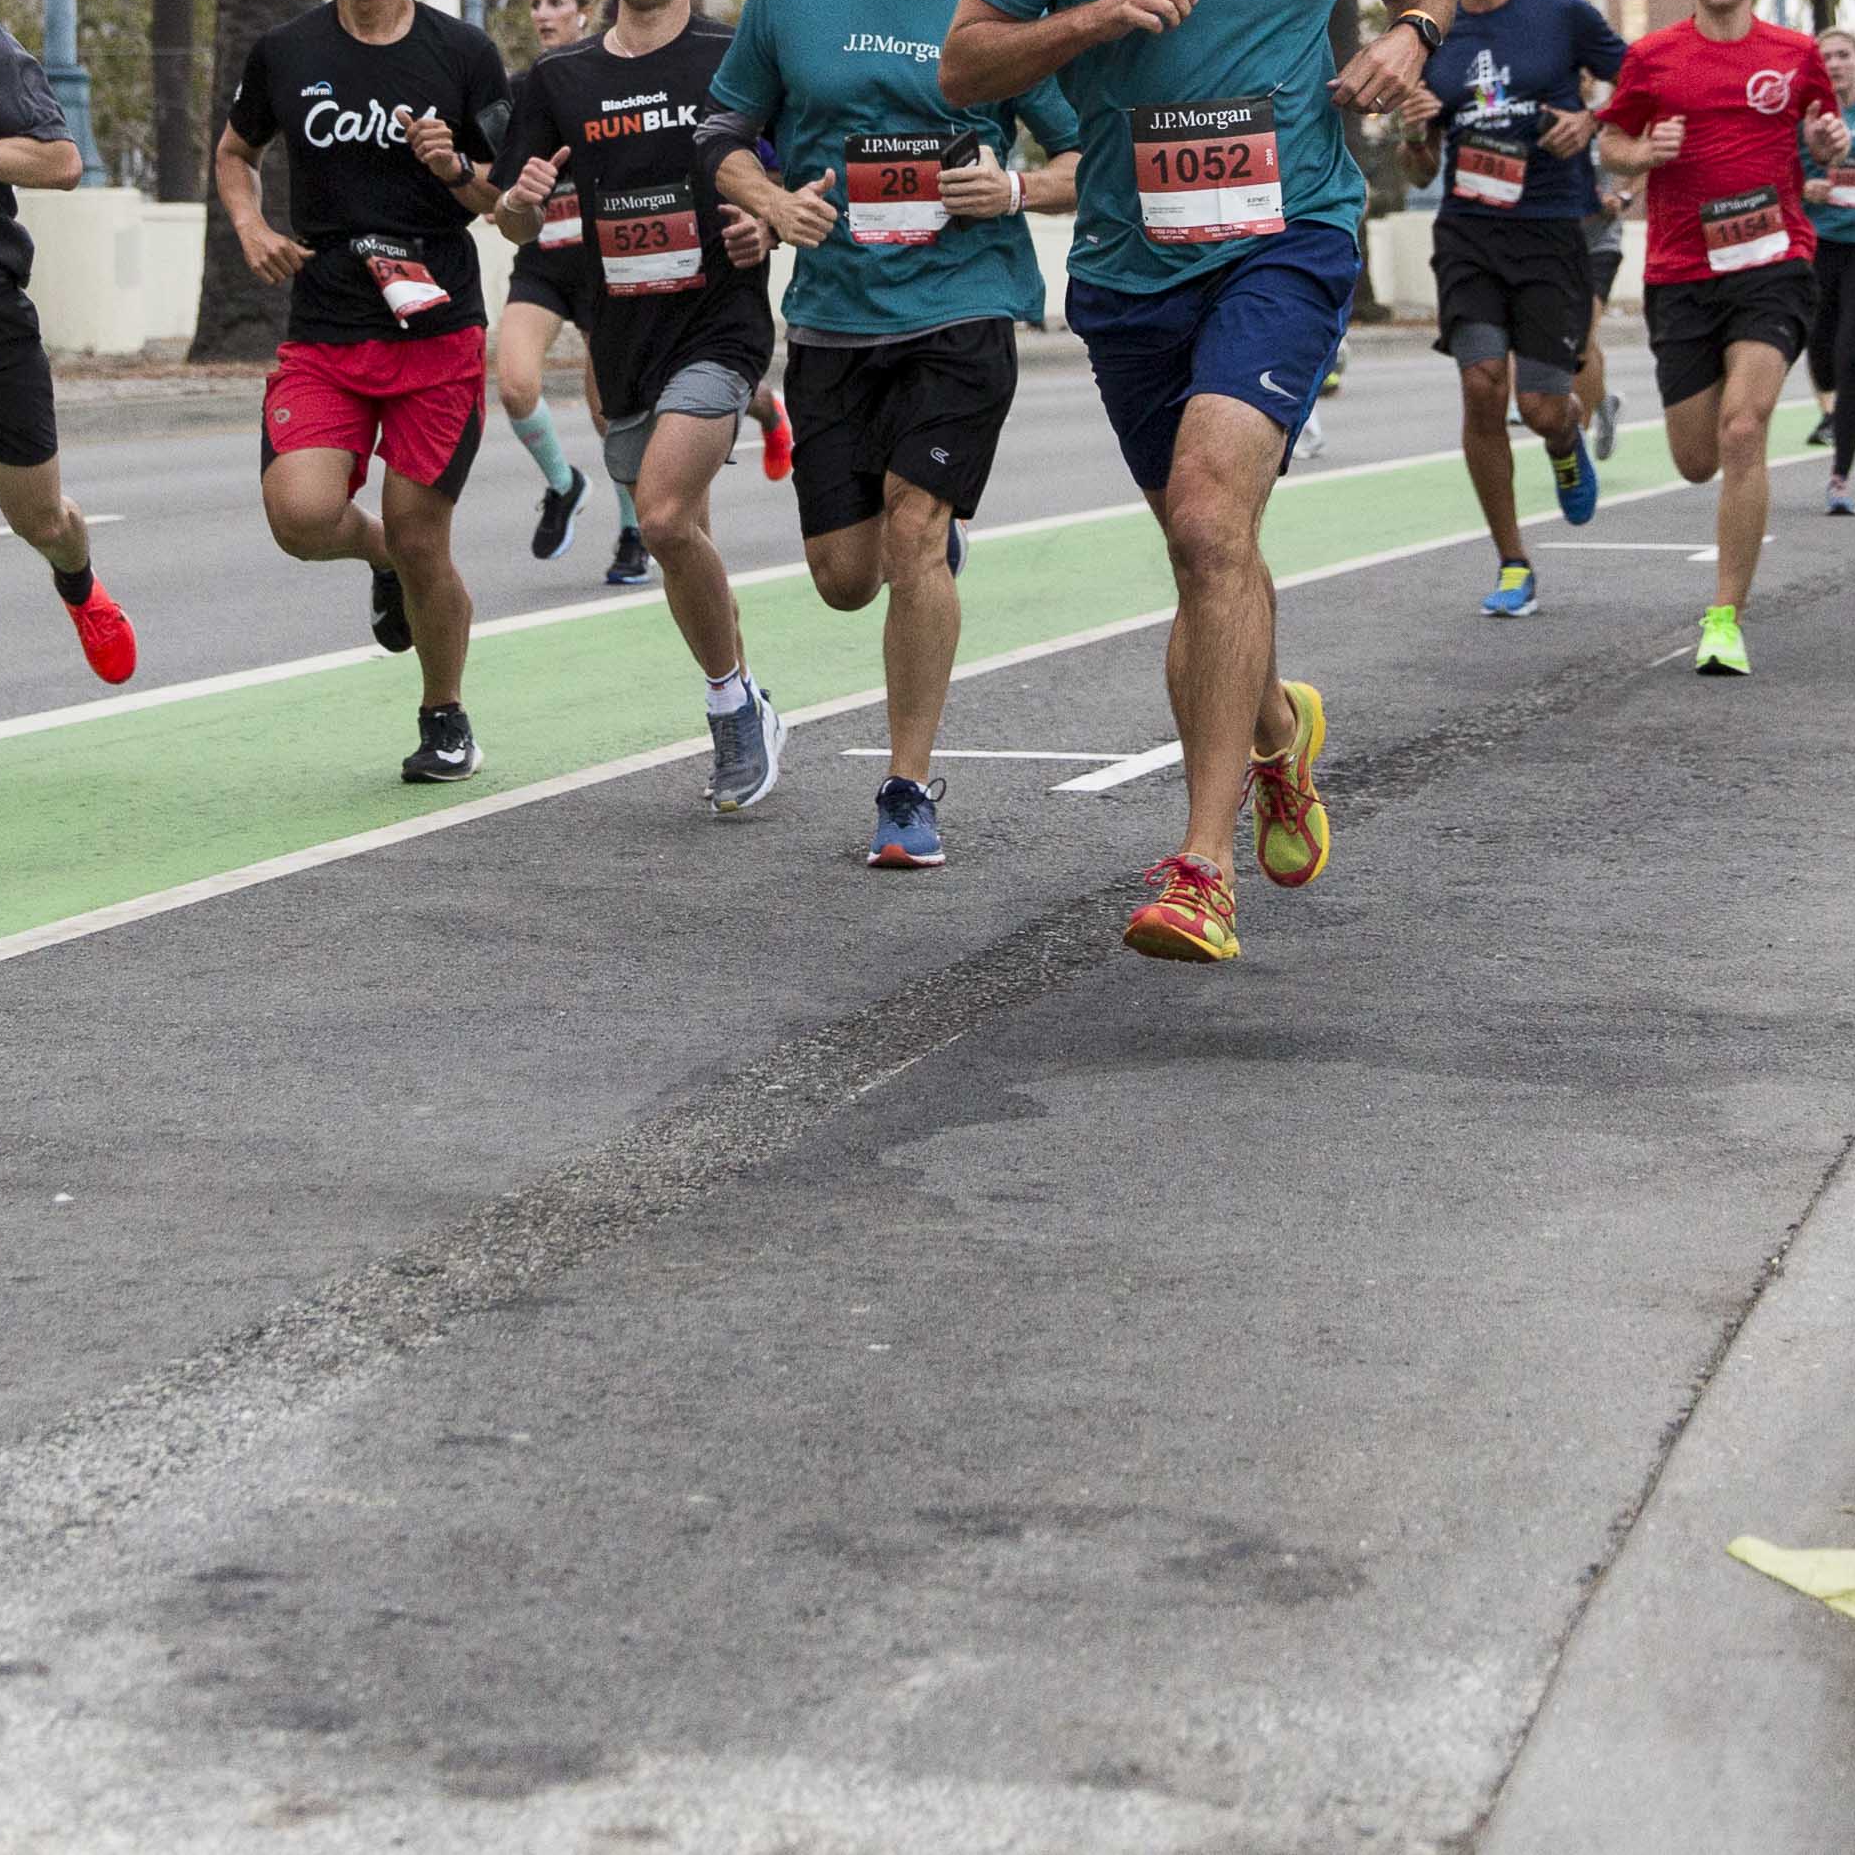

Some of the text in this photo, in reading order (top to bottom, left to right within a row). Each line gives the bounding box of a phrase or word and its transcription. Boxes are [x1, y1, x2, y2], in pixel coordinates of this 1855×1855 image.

[844, 33, 941, 62] J.P.Morga
[300, 83, 332, 97] affirm
[601, 91, 668, 112] BlackRock
[584, 105, 698, 143] RUNBLK
[1150, 108, 1251, 130] J.P.Morgan
[861, 137, 940, 155] J.P.Morgan
[1151, 143, 1252, 184] 1052
[880, 167, 919, 197] 28
[603, 193, 676, 211] J.P.Morgan
[614, 221, 670, 251] 523
